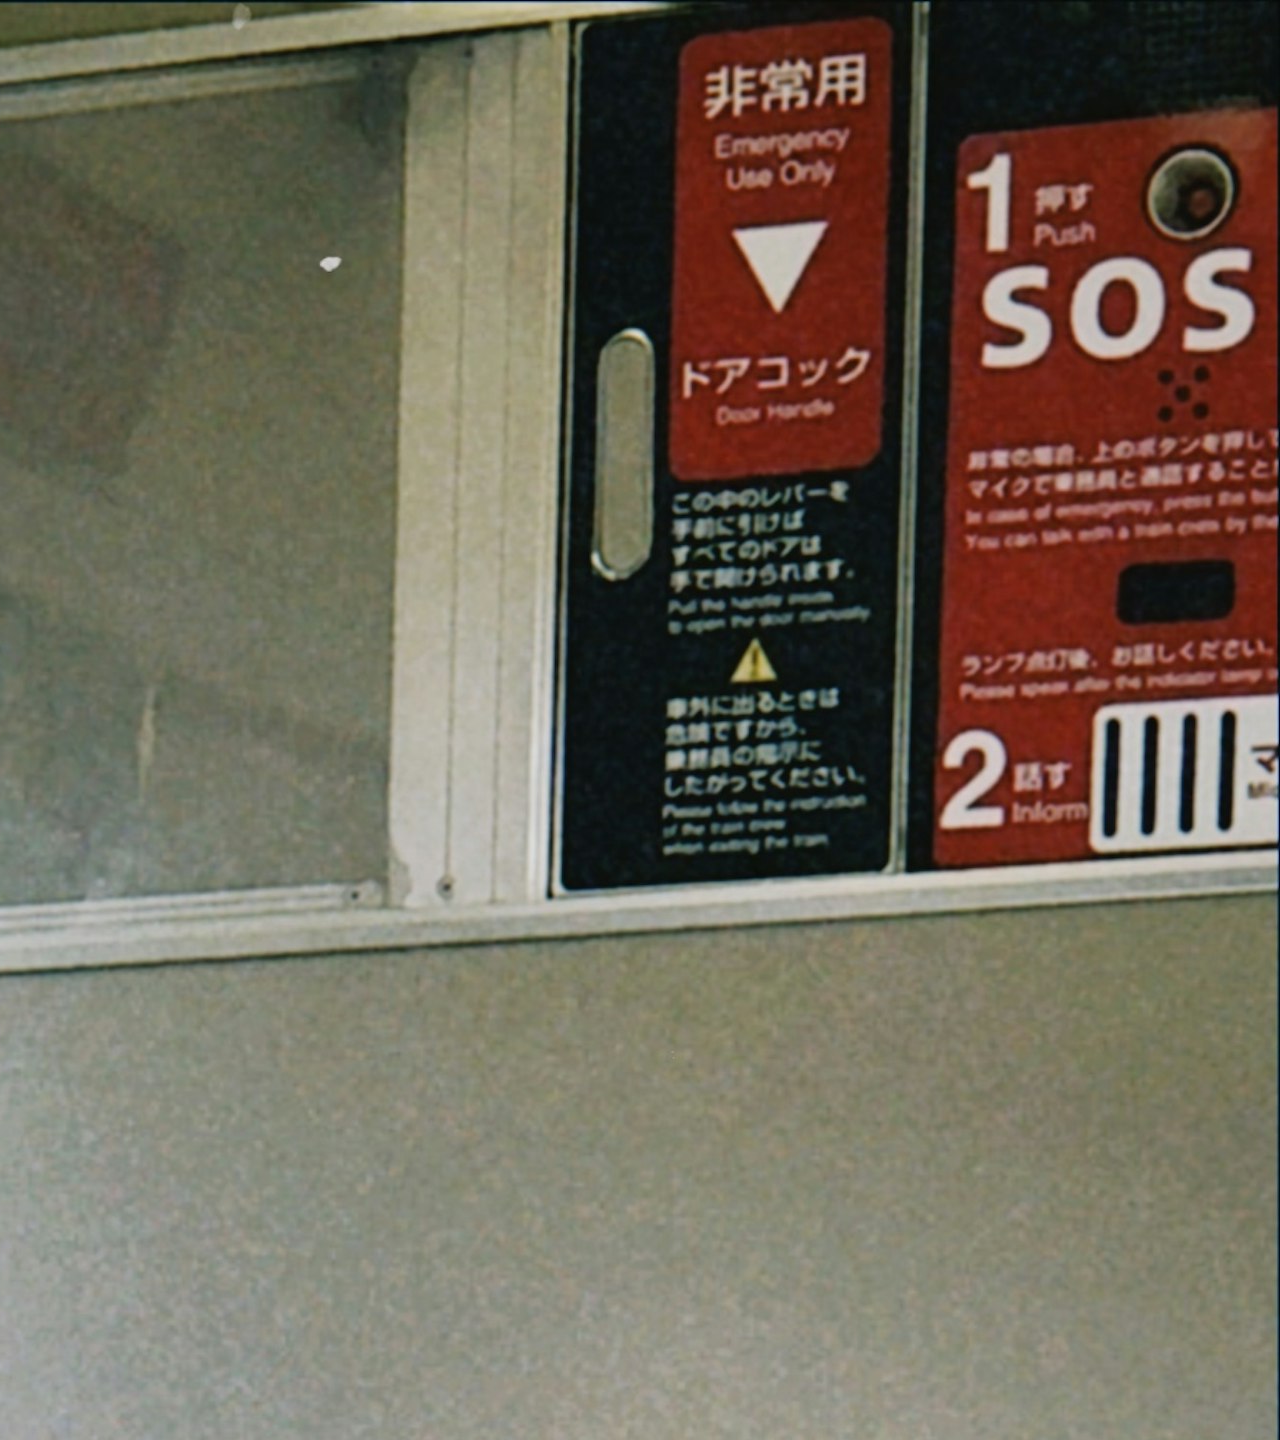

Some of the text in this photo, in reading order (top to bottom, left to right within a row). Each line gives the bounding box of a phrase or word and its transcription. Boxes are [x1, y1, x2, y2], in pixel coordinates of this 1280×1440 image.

[703, 53, 867, 119] 非常用
[715, 127, 850, 159] Emergency
[726, 159, 836, 191] Use Only
[966, 152, 1011, 252] 1
[1033, 221, 1096, 247] Push
[981, 246, 1257, 369] SOS
[682, 346, 871, 399] ドアコック
[940, 728, 1008, 830] 2
[1012, 761, 1073, 793] 話す
[1011, 800, 1089, 824] Inform
